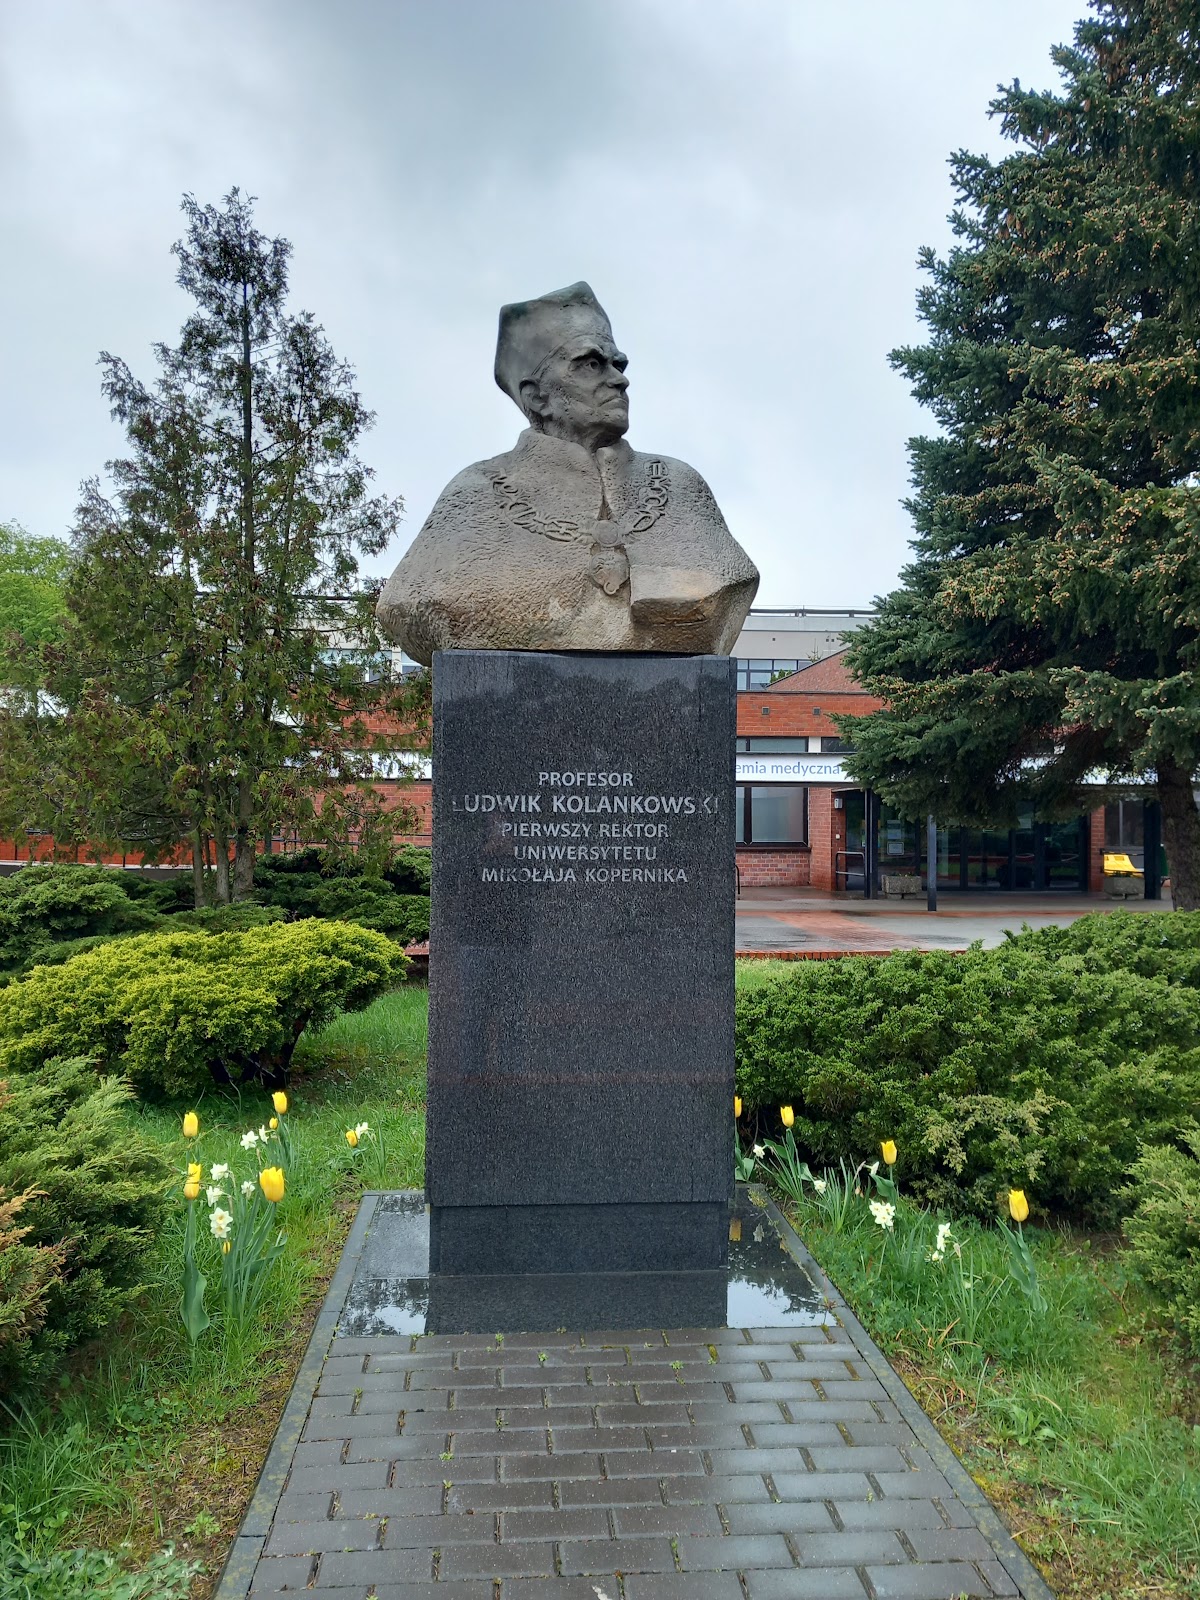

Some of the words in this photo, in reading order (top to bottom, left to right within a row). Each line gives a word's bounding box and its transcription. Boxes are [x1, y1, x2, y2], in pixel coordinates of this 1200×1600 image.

[736, 761, 767, 774] emia
[771, 761, 840, 777] medyczna
[538, 772, 634, 787] PROFESOR
[452, 794, 542, 813] LUDWIK
[552, 795, 719, 814] KOLANKOWSKI
[501, 822, 592, 837] PIERWSZY
[600, 823, 669, 838] REKTOR
[514, 846, 657, 860] UNIWERSYTETU
[481, 867, 577, 883] MIKOŁAJA
[585, 868, 689, 883] KOPERNIKA
